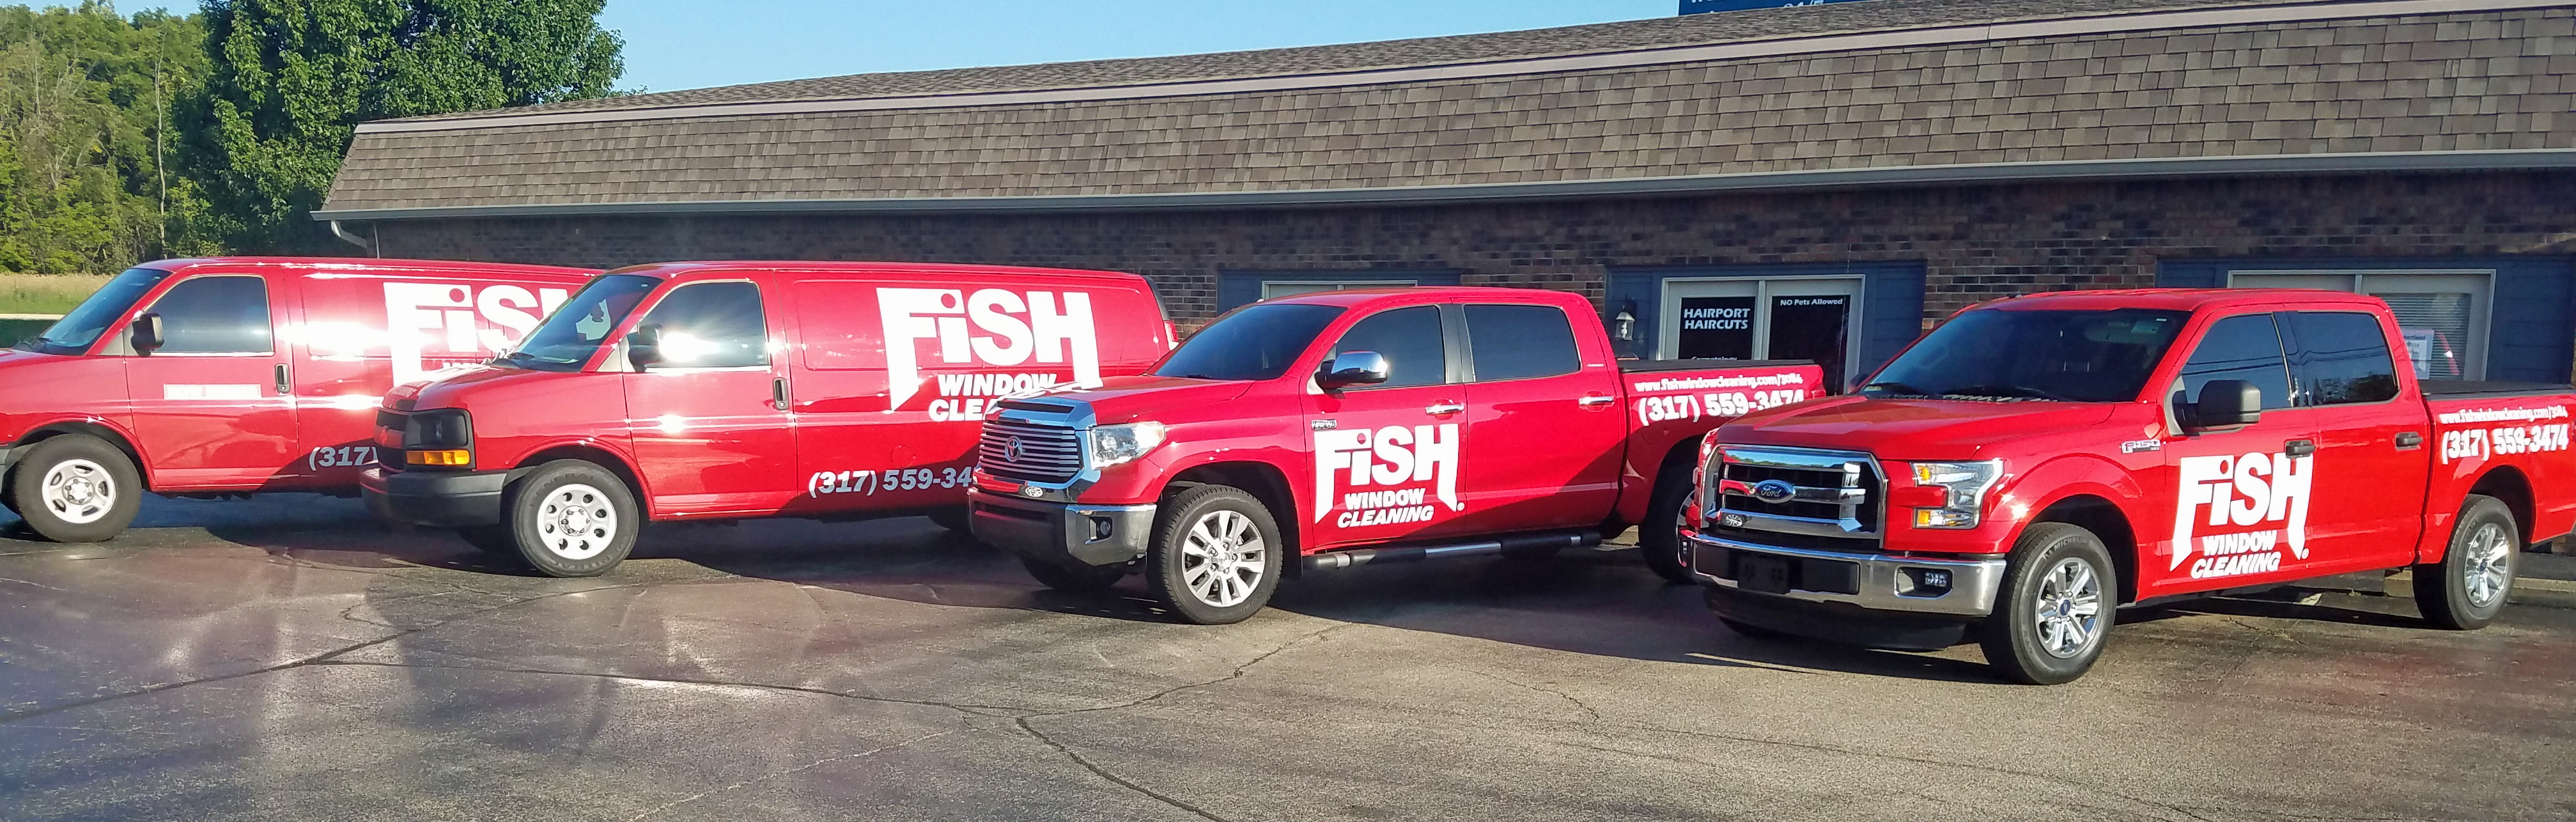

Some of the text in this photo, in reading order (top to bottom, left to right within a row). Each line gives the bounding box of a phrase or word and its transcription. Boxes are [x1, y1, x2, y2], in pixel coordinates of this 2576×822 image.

[1684, 308, 1751, 319] HAIRPORT
[1684, 320, 1748, 330] HAIRCUTS
[1638, 389, 1804, 426] (317) 559-3474
[2442, 424, 2570, 465] (317) 559-3474
[309, 446, 379, 471] (317)
[809, 466, 973, 499] (317) 559-34
[1760, 485, 1783, 498] Ford
[1345, 488, 1426, 510] WINDOW
[1337, 505, 1434, 529] CLEANING
[2203, 530, 2277, 557] WINDOW
[2191, 552, 2282, 579] CLEANING
